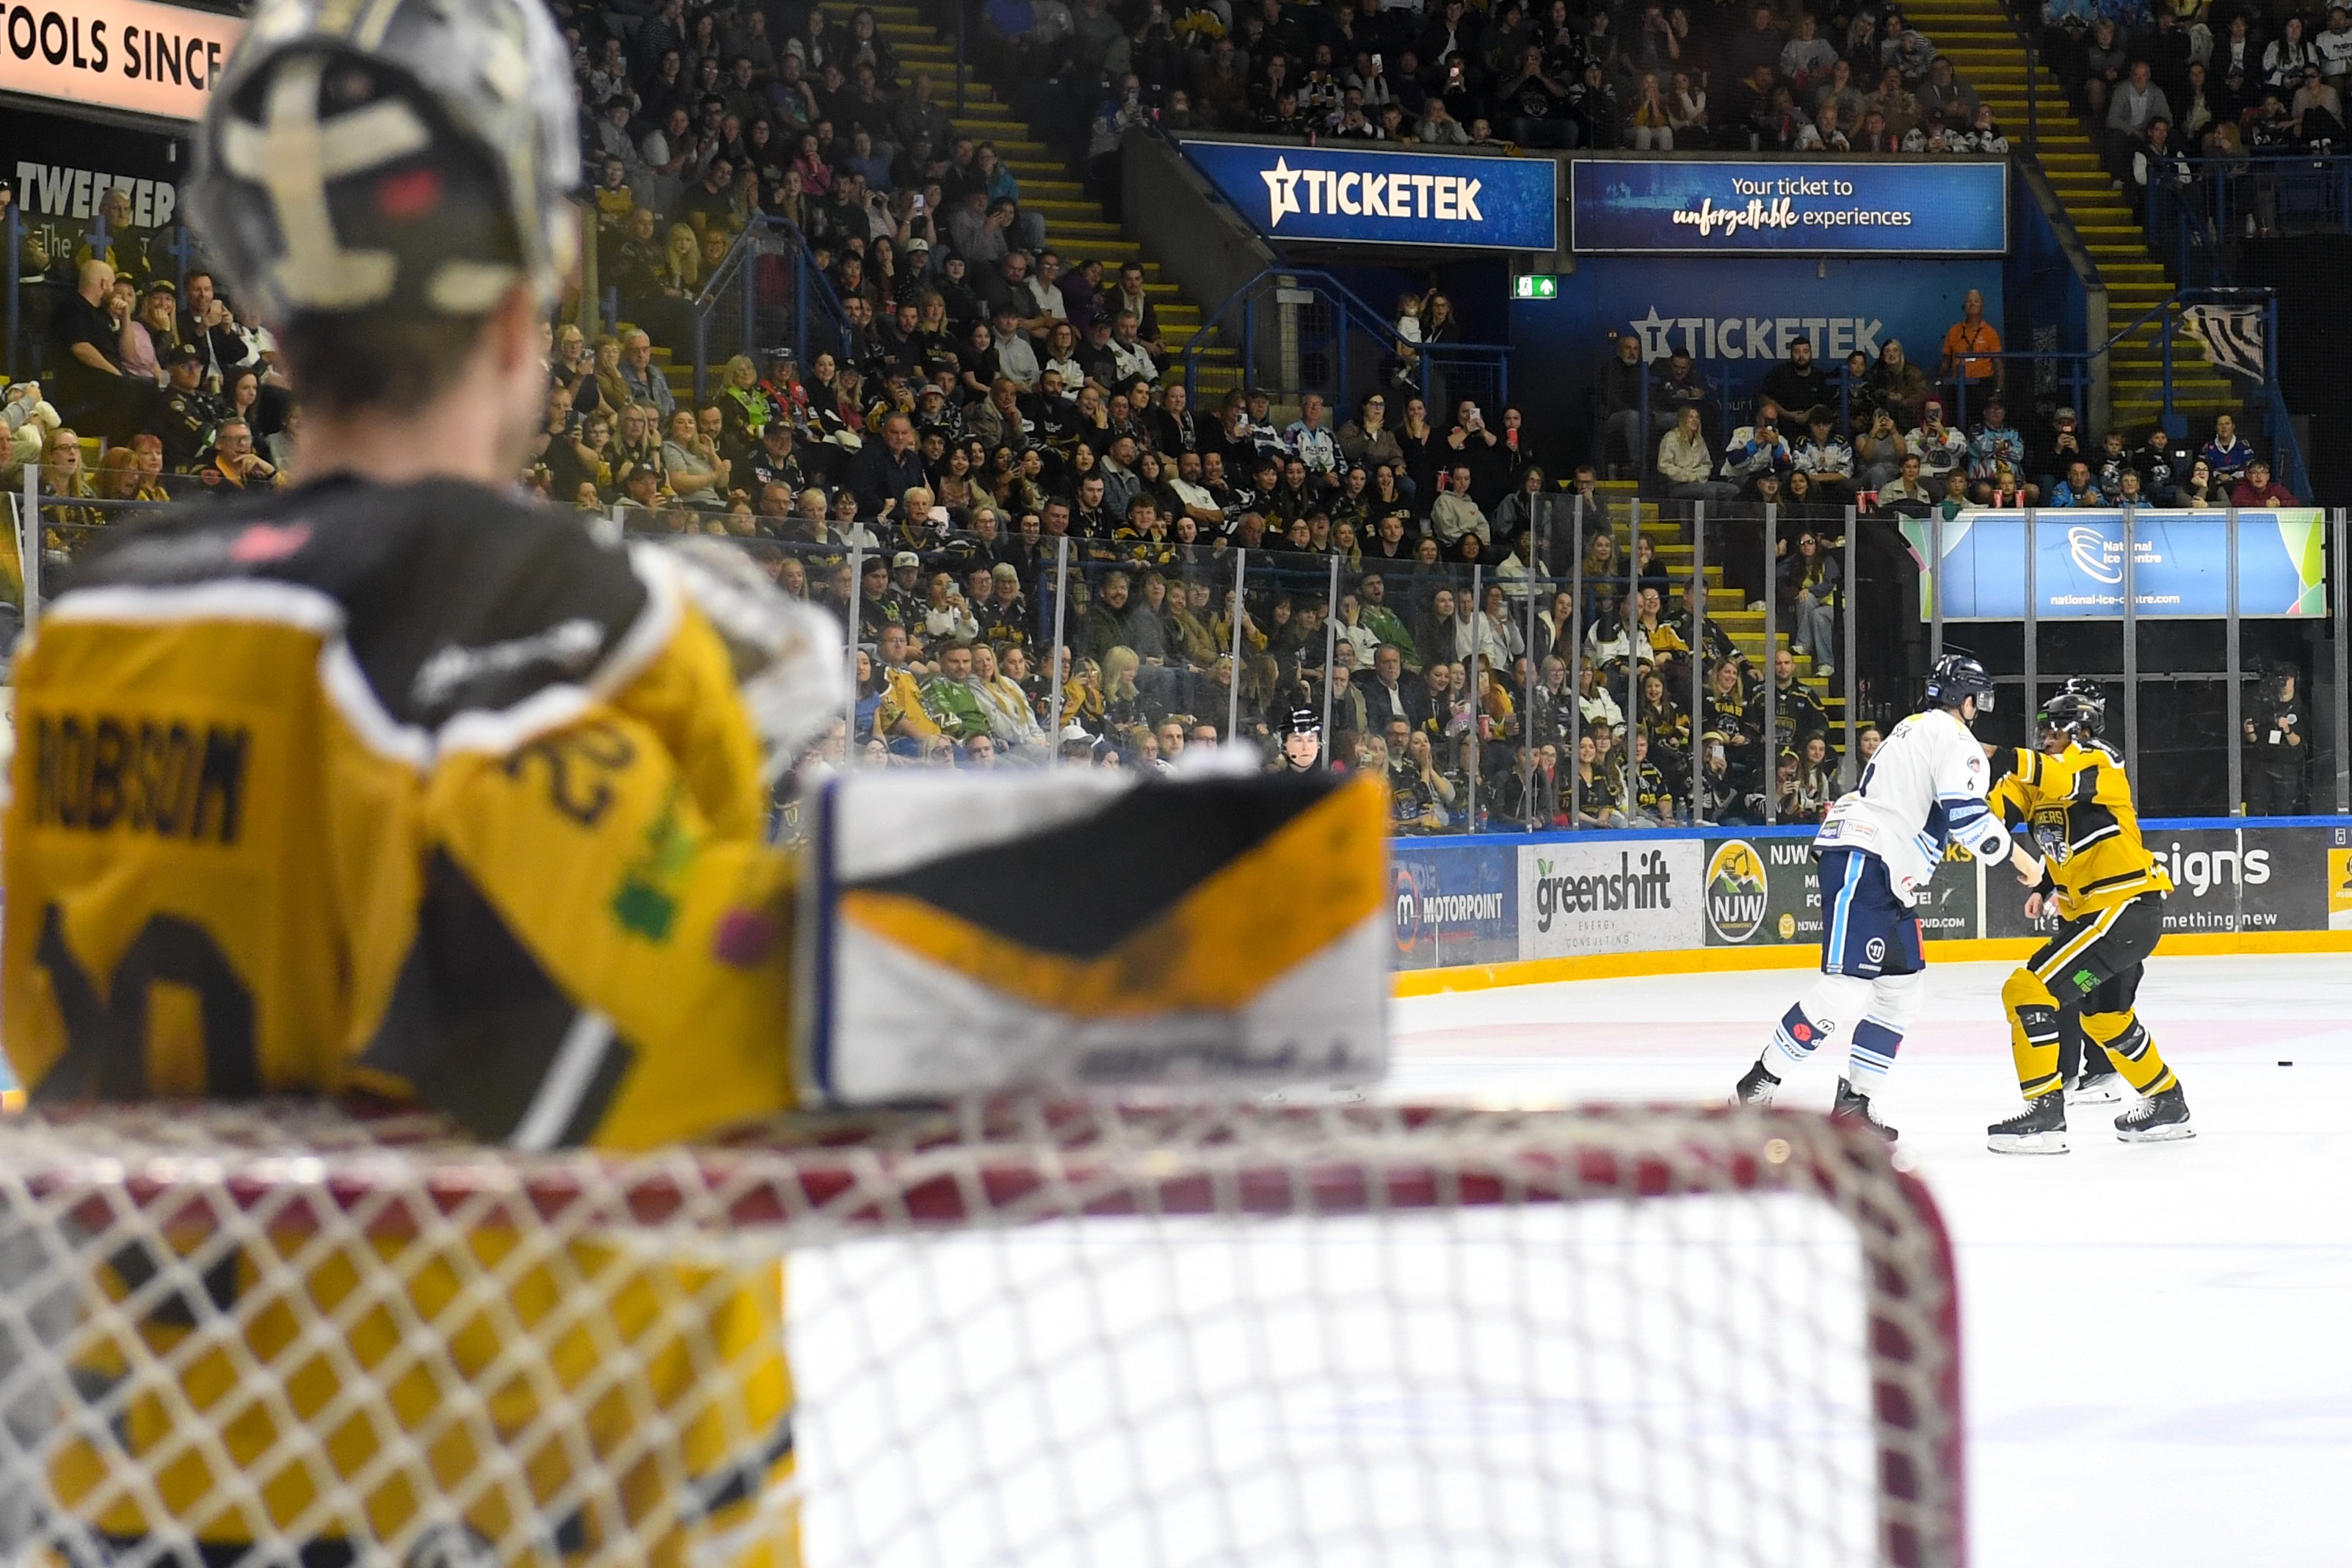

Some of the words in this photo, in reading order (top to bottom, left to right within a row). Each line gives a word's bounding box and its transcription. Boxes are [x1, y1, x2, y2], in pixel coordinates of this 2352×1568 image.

[0, 4, 109, 73] OOLS
[1303, 170, 1484, 221] TICKETEK
[1732, 177, 1774, 195] Your
[1777, 176, 1829, 195] ticket
[1833, 179, 1854, 195] to
[1672, 197, 1800, 236] unforgettable
[1803, 208, 1912, 229] experiences
[41, 222, 72, 258] The
[1677, 317, 1883, 359] TICKETEK
[2103, 541, 2152, 551] Natnal
[2103, 554, 2121, 564] Ice
[2050, 595, 2181, 605] national-ice-ctre.com
[1770, 845, 1810, 865] NJW
[1536, 849, 1671, 933] greenshift
[1423, 893, 1503, 923] MOTORPOINT
[1714, 895, 1763, 922] NJW
[1578, 920, 1616, 931] ENERGY
[2162, 912, 2235, 929] mething
[2242, 912, 2278, 926] new
[1566, 934, 1630, 948] CONSULTING
